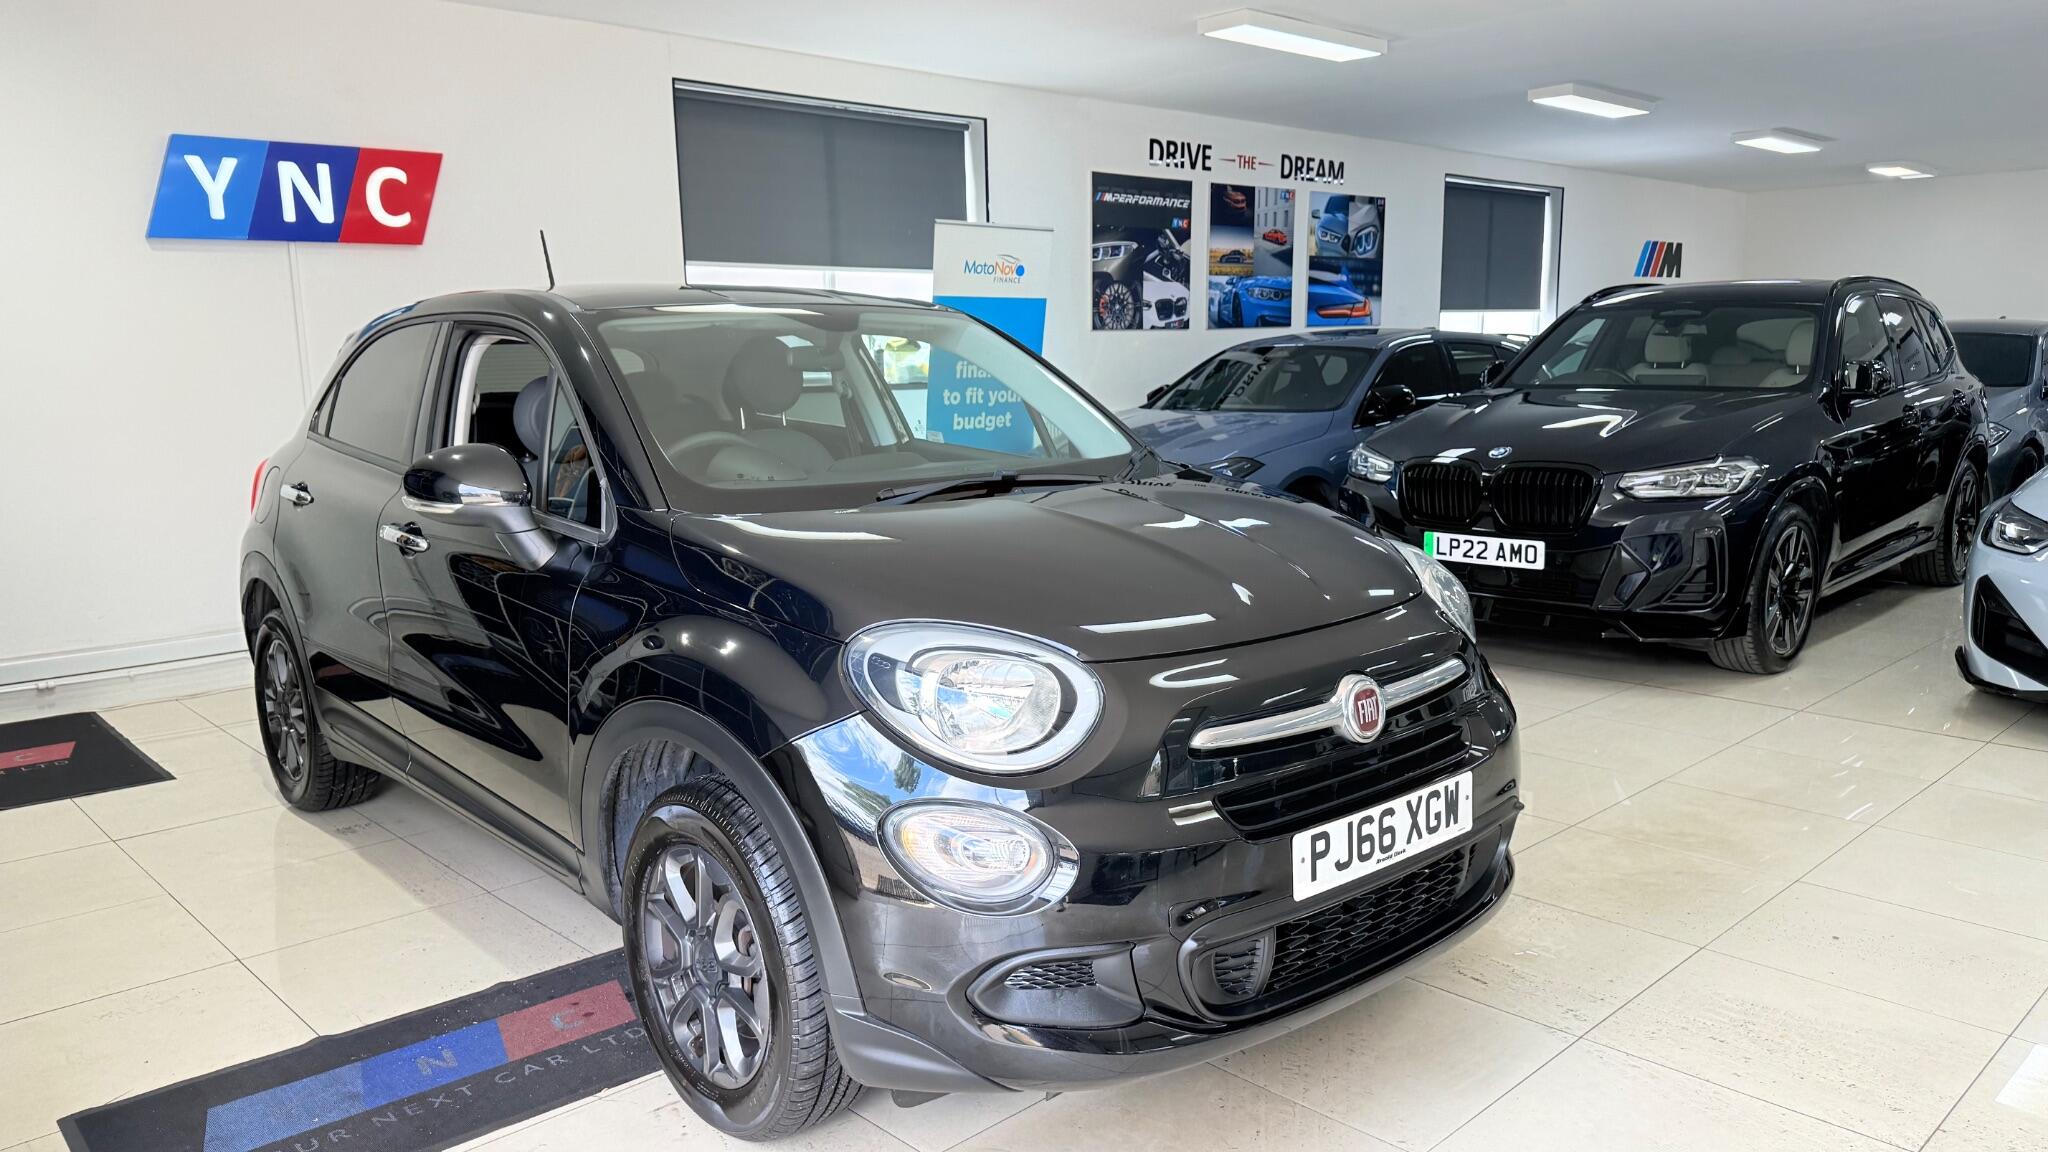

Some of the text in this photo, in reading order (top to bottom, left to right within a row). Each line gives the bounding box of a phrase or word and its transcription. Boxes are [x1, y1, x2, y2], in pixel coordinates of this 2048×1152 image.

[1149, 138, 1345, 185] DRIVE THE DREAM
[183, 154, 412, 228] YNC
[993, 276, 1021, 284] FINANCE
[956, 360, 991, 379] fina
[943, 389, 961, 406] to
[965, 387, 984, 404] fit
[953, 412, 1012, 431] budget
[1436, 537, 1538, 564] LP22 AMO
[1358, 696, 1378, 725] FIAT
[1311, 781, 1460, 882] PJ66 XGW
[371, 1084, 472, 1127] NEXT
[494, 1054, 569, 1084] CAR
[581, 1027, 647, 1054] LTD
